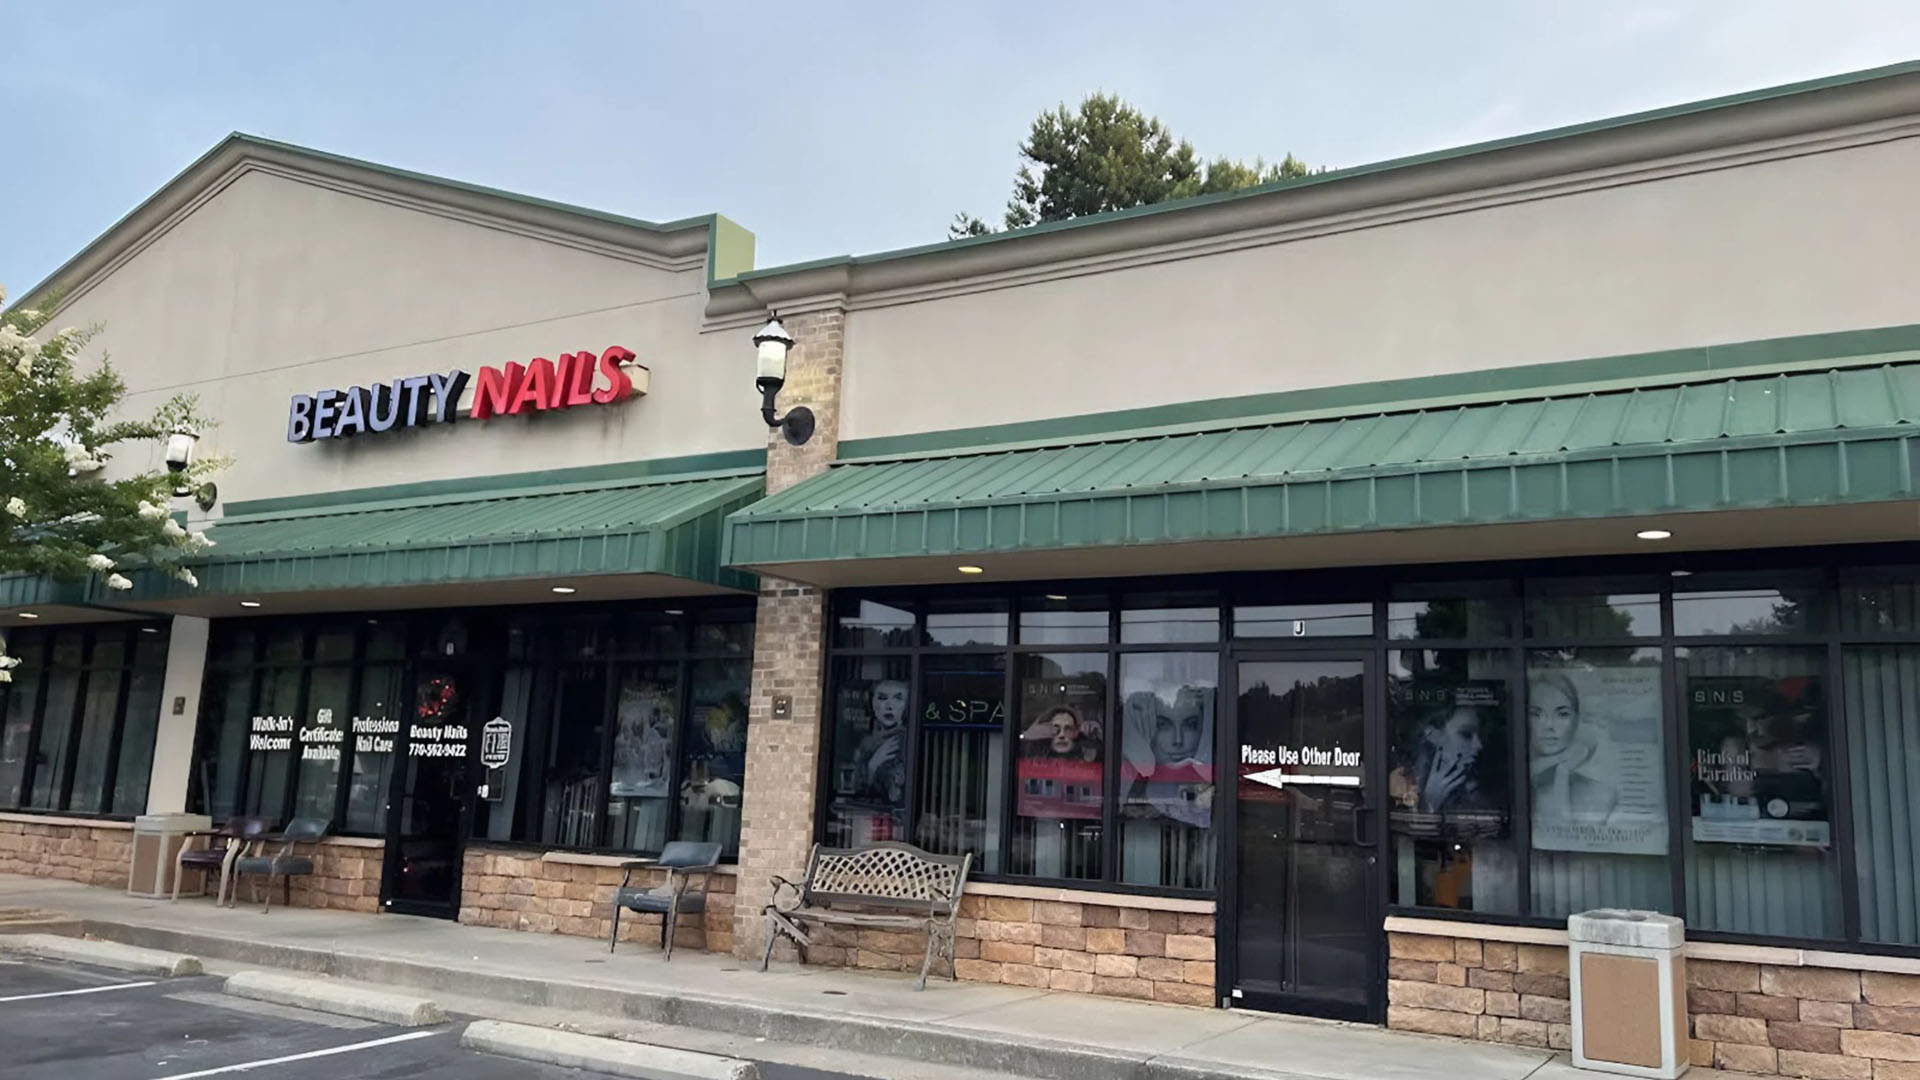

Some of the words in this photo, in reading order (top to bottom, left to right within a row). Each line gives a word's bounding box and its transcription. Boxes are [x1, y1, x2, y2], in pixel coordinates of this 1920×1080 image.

[288, 369, 470, 443] BEAUTY
[470, 346, 637, 420] NAILS
[1295, 621, 1304, 635] J
[1695, 690, 1745, 703] SNS
[925, 702, 940, 720] &
[948, 700, 1006, 723] SPA
[410, 724, 443, 742] Beauty
[444, 724, 468, 740] Nails
[250, 734, 292, 751] Welcome
[374, 735, 394, 753] Care
[1241, 744, 1277, 765] Please
[1278, 745, 1299, 765] Use
[1301, 745, 1332, 766] Other
[1334, 746, 1361, 767] Door
